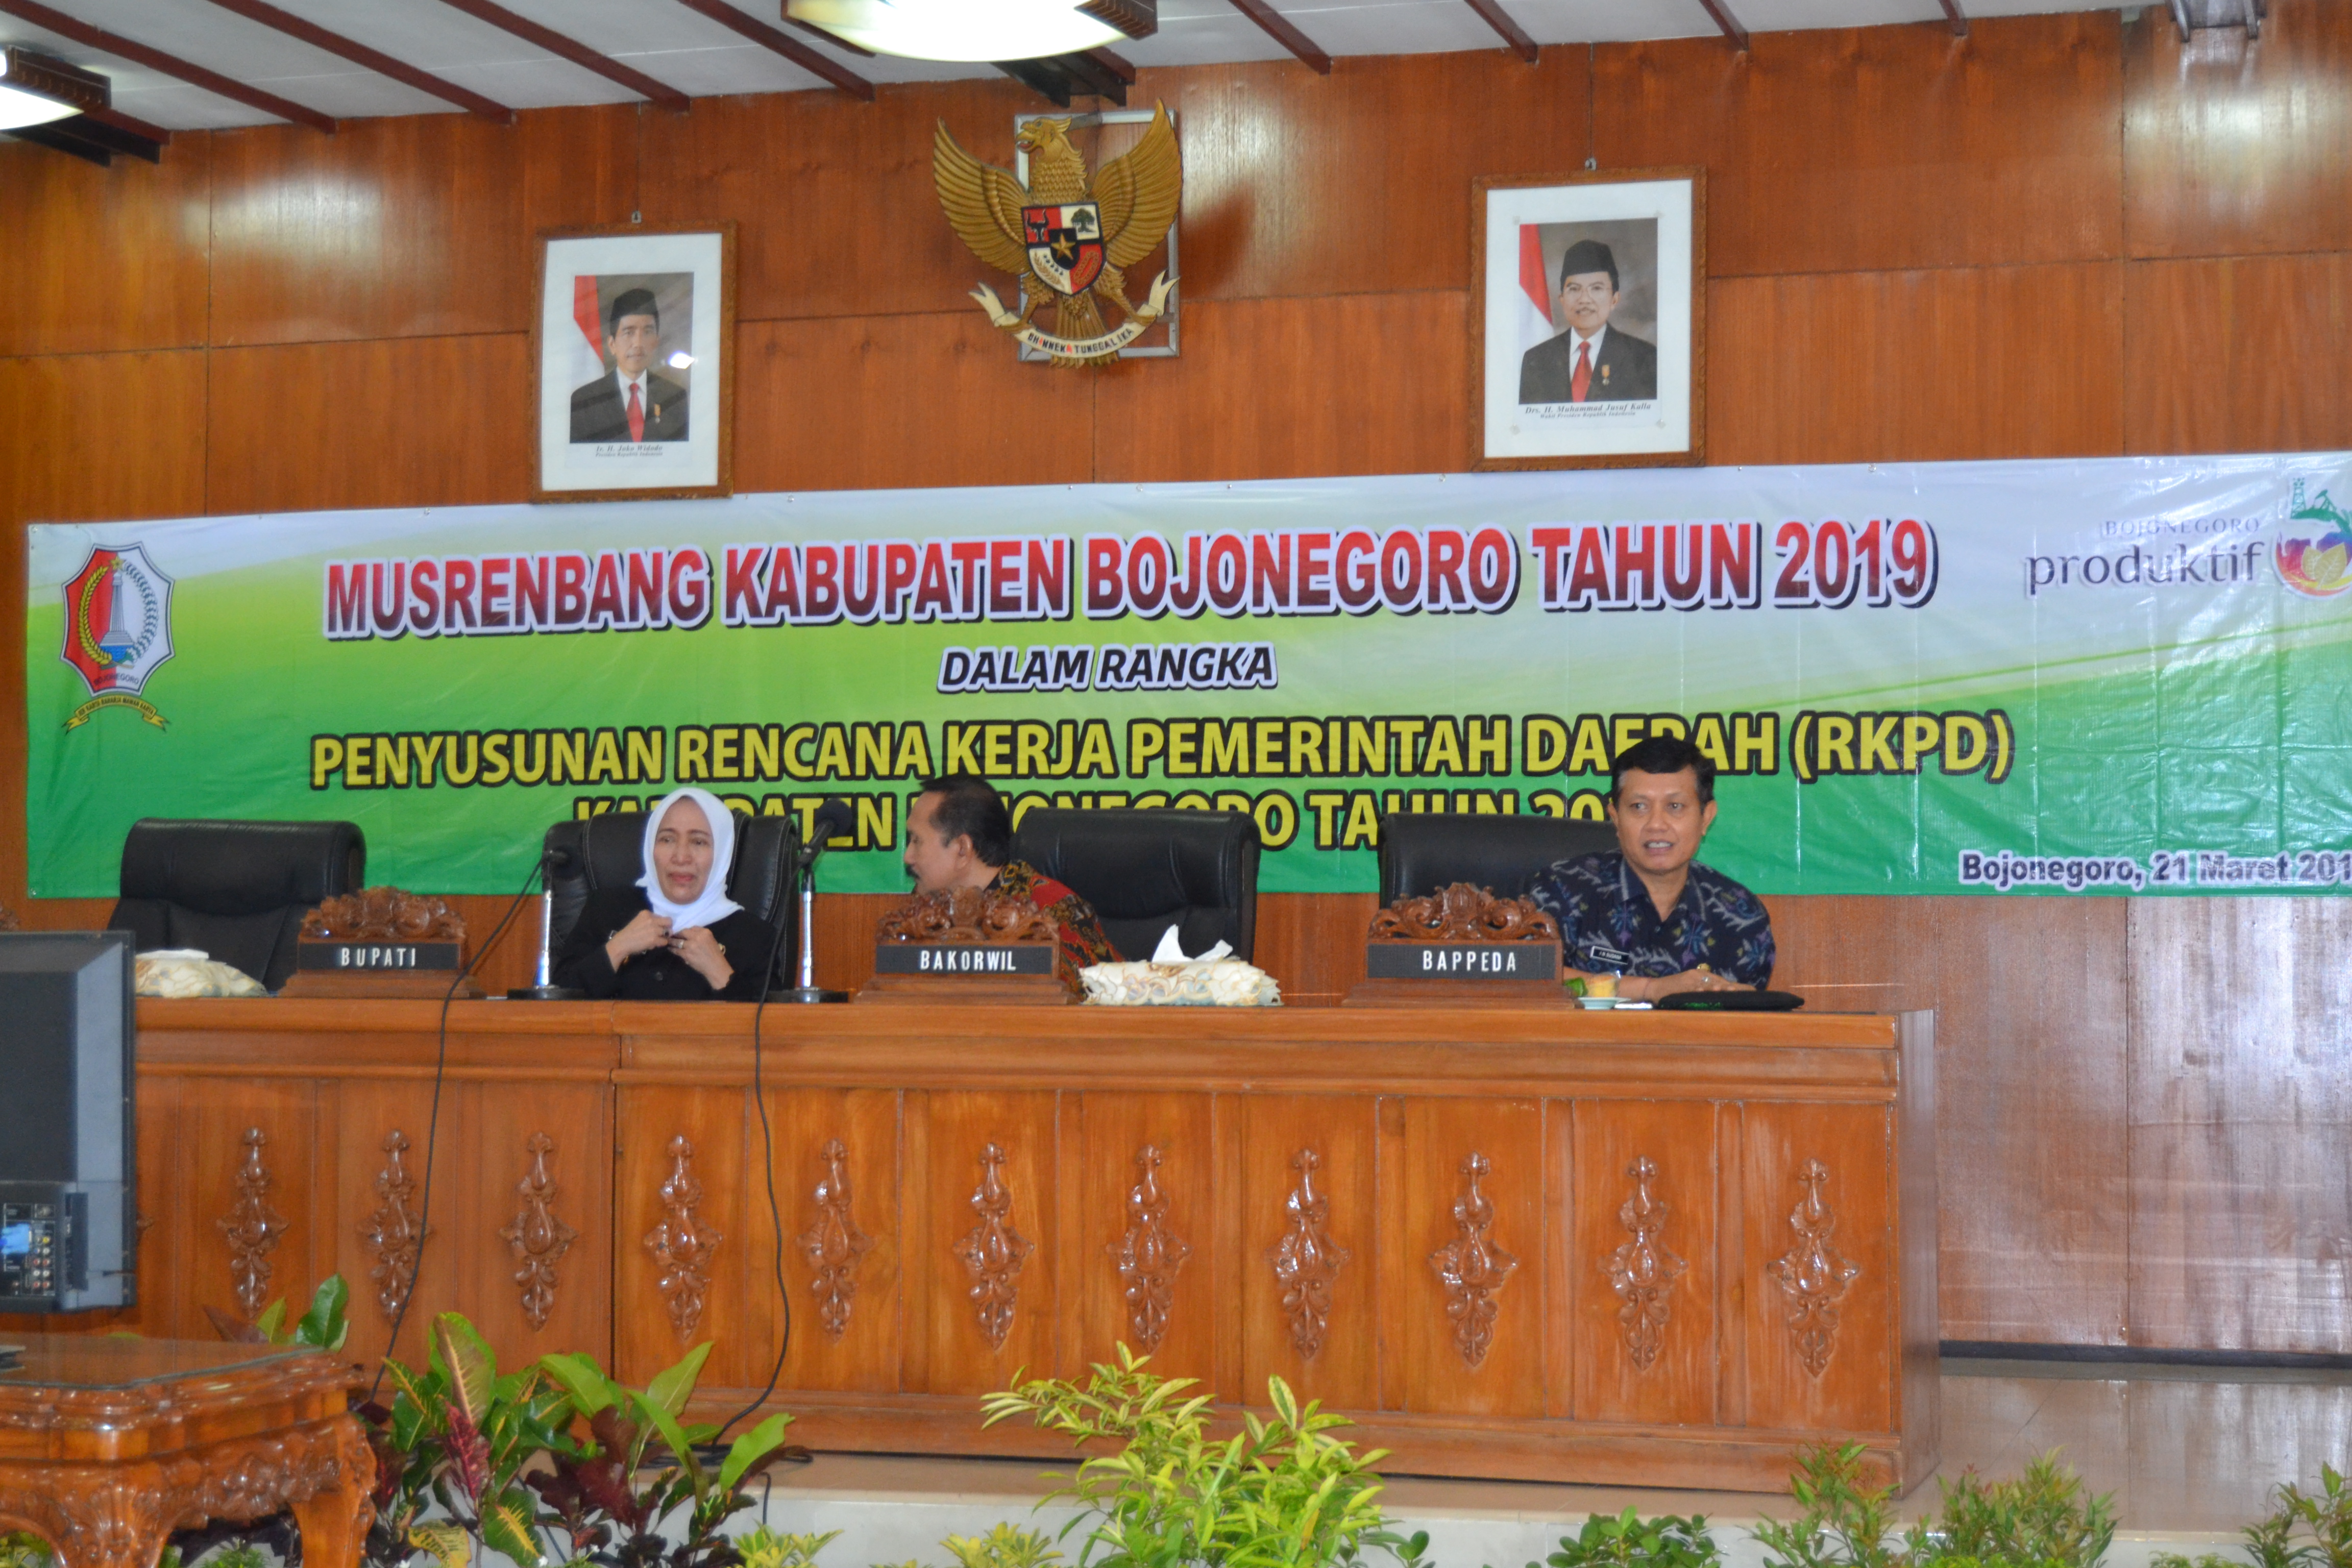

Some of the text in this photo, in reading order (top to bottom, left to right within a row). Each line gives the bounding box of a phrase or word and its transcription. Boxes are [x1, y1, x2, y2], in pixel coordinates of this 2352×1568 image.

[1074, 338, 1117, 353] TUNGGAL
[1116, 328, 1134, 342] IKA
[1557, 404, 1603, 412] Muhammad
[1605, 403, 1628, 411] Jusuf
[2104, 517, 2260, 537] BOJONEGORO
[325, 516, 1930, 636] MUSRENBANG KABUPATEN BOJONEGORO TAHUN 2019
[2028, 541, 2265, 596] produktif
[941, 645, 1275, 687] DALAM RANGKA
[312, 729, 665, 789] PENYUSUNAN
[677, 724, 934, 783] RENCANA
[945, 722, 1117, 778] KERJA
[1130, 717, 1509, 776] PEMERINTAH
[1793, 713, 2011, 781] (RKPD)
[1962, 852, 2352, 887] Bojonegoro, 21 Maret 201
[340, 947, 416, 967] BUPATI
[920, 950, 1017, 971] BAKORWIL
[1422, 950, 1516, 972] BAPPEDA
